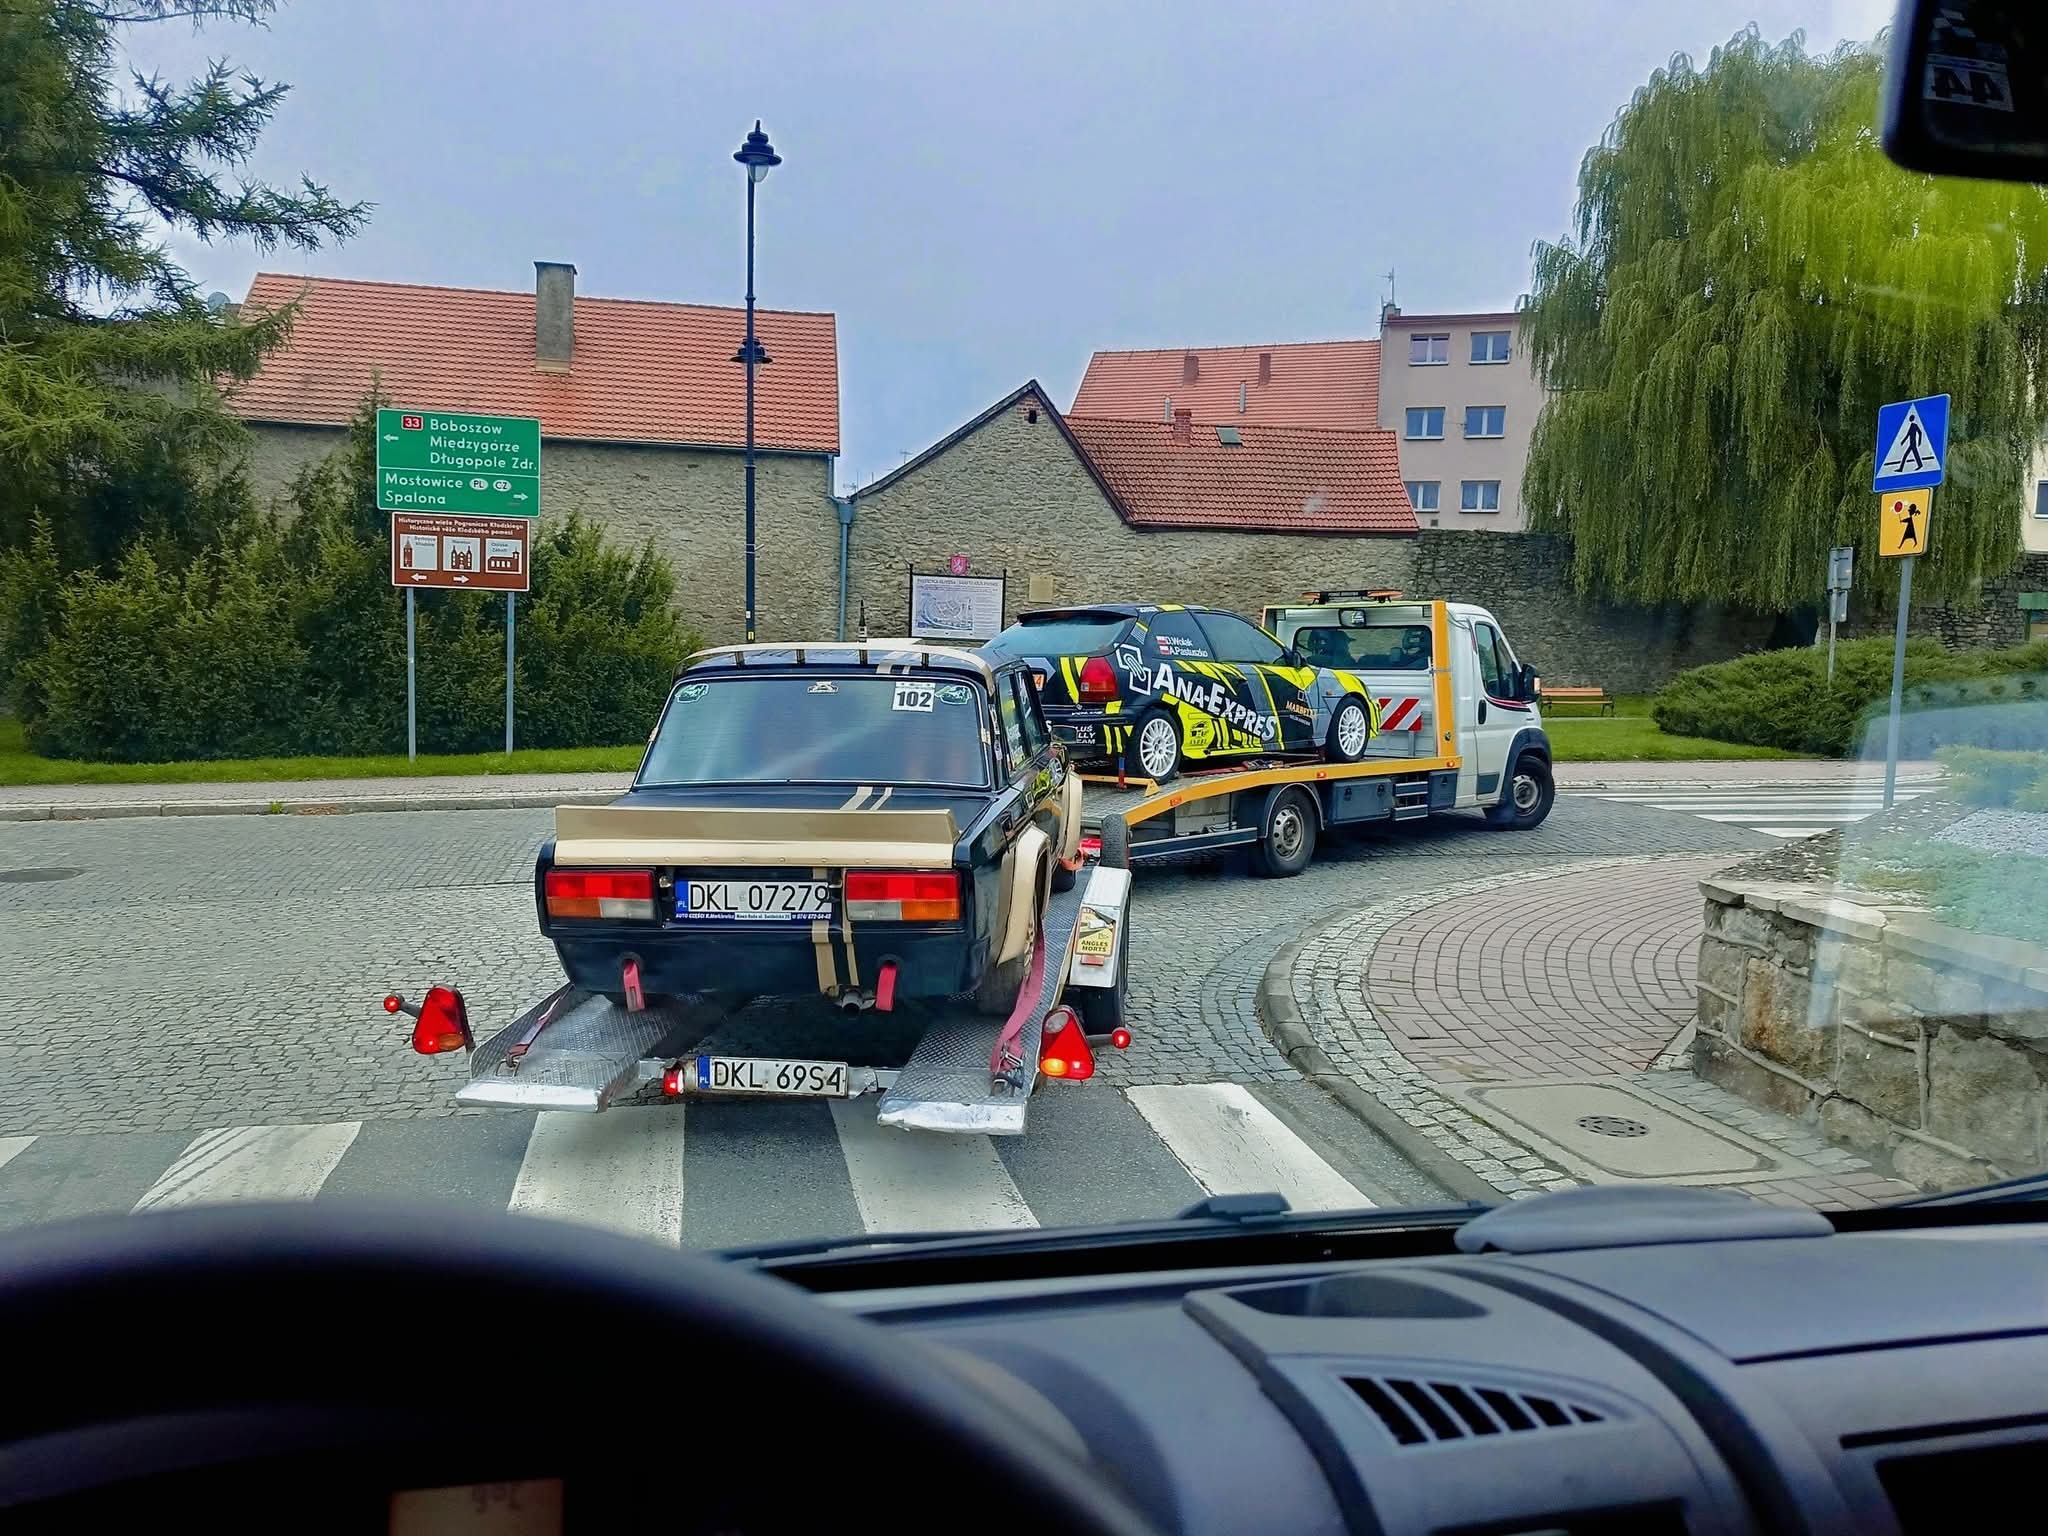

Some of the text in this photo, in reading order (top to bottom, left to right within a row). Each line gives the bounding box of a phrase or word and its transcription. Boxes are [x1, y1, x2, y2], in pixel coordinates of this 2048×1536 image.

[404, 417, 420, 428] 33
[430, 435, 520, 453] Międzygórze
[430, 452, 537, 470] Długopole Zdr.
[385, 473, 508, 490] Mostowice PL CZ
[385, 490, 446, 505] Spalona
[897, 691, 932, 708] 102
[690, 884, 830, 911] DKL 07279
[700, 1076, 709, 1084] PL
[714, 1060, 842, 1092] DKL 69S4
